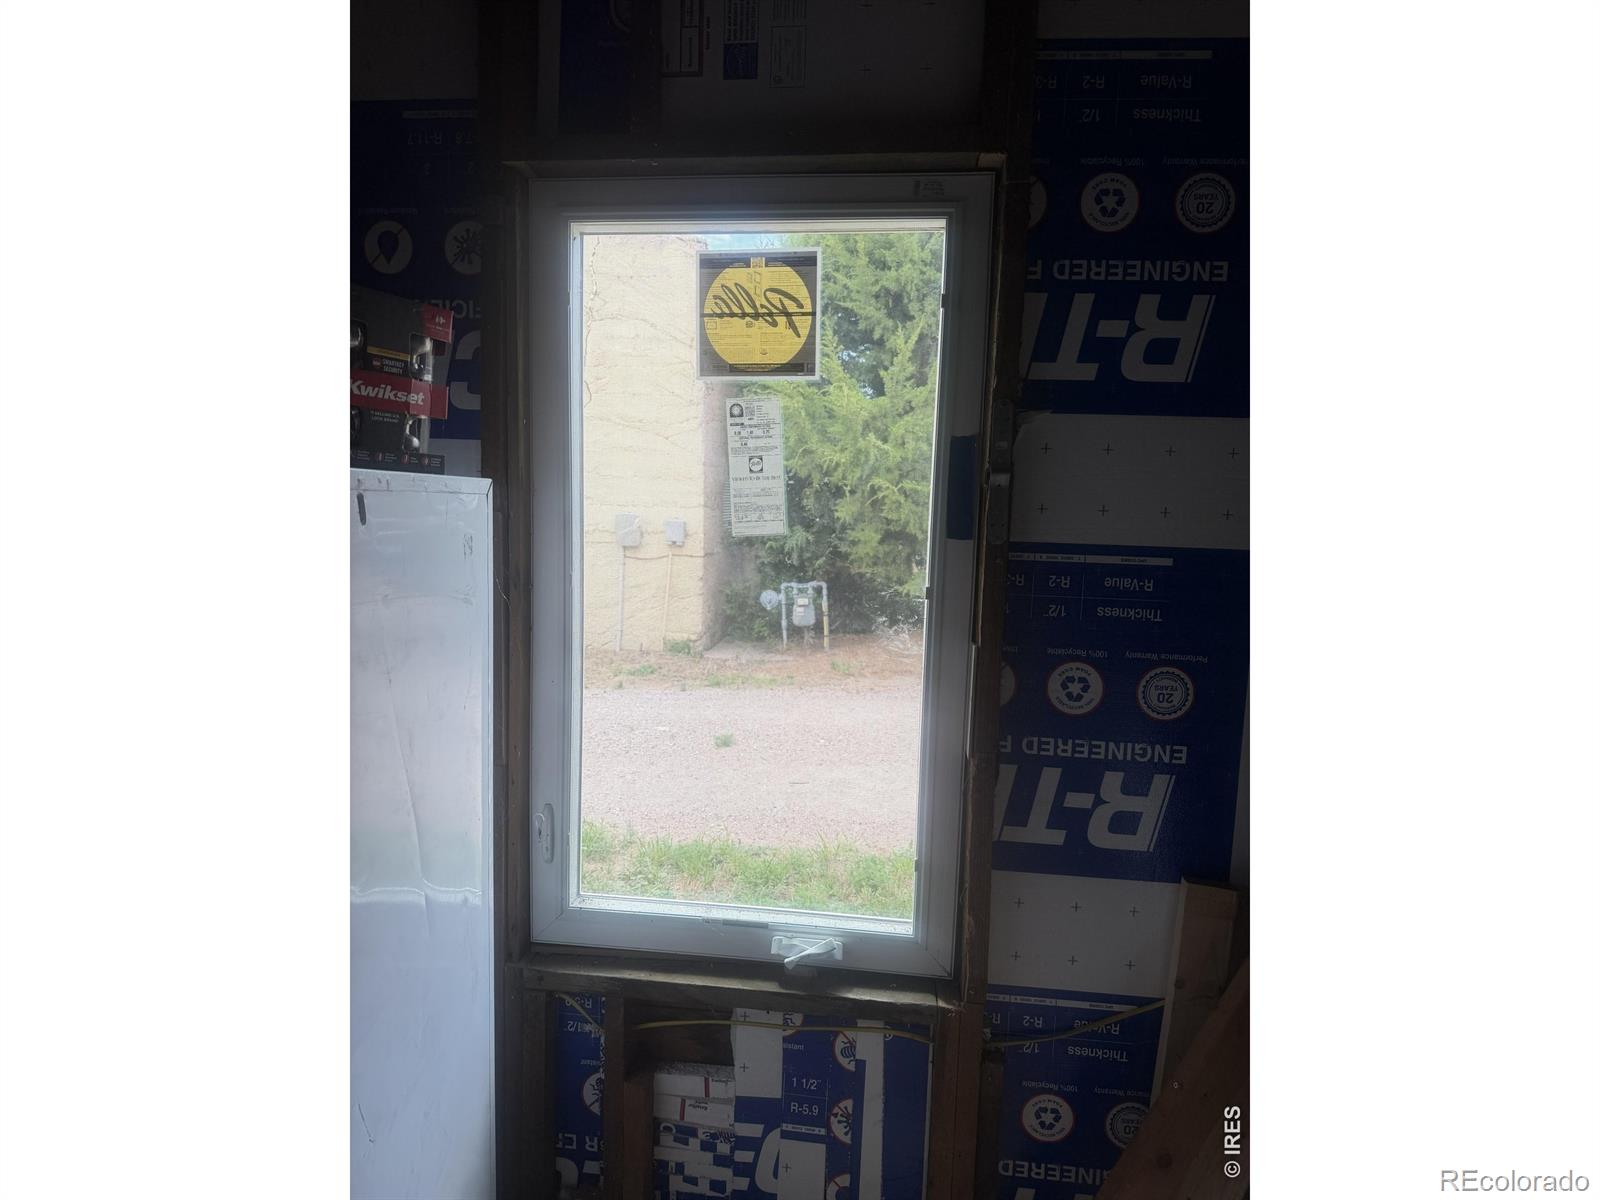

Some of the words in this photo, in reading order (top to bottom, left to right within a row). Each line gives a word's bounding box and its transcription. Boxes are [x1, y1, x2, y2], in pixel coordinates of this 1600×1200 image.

[1081, 74, 1105, 89] R-2
[1140, 74, 1192, 89] R-Value
[1133, 108, 1201, 123] Thickness
[1193, 191, 1219, 201] YEARS
[1196, 202, 1214, 214] 20
[1052, 260, 1230, 282] ENGINEERED
[350, 379, 425, 406] Kwikset
[1048, 575, 1071, 588] R-2
[1104, 575, 1154, 592] R-Value
[1096, 606, 1163, 622] Thickness
[1160, 653, 1209, 664] Performance
[1157, 692, 1174, 704] 20
[1021, 736, 1188, 764] ENGINEERED
[1022, 1015, 1043, 1029] R-2
[1067, 1046, 1129, 1063] Thickness
[791, 1077, 797, 1088] 1
[790, 1102, 819, 1116] R-5.9
